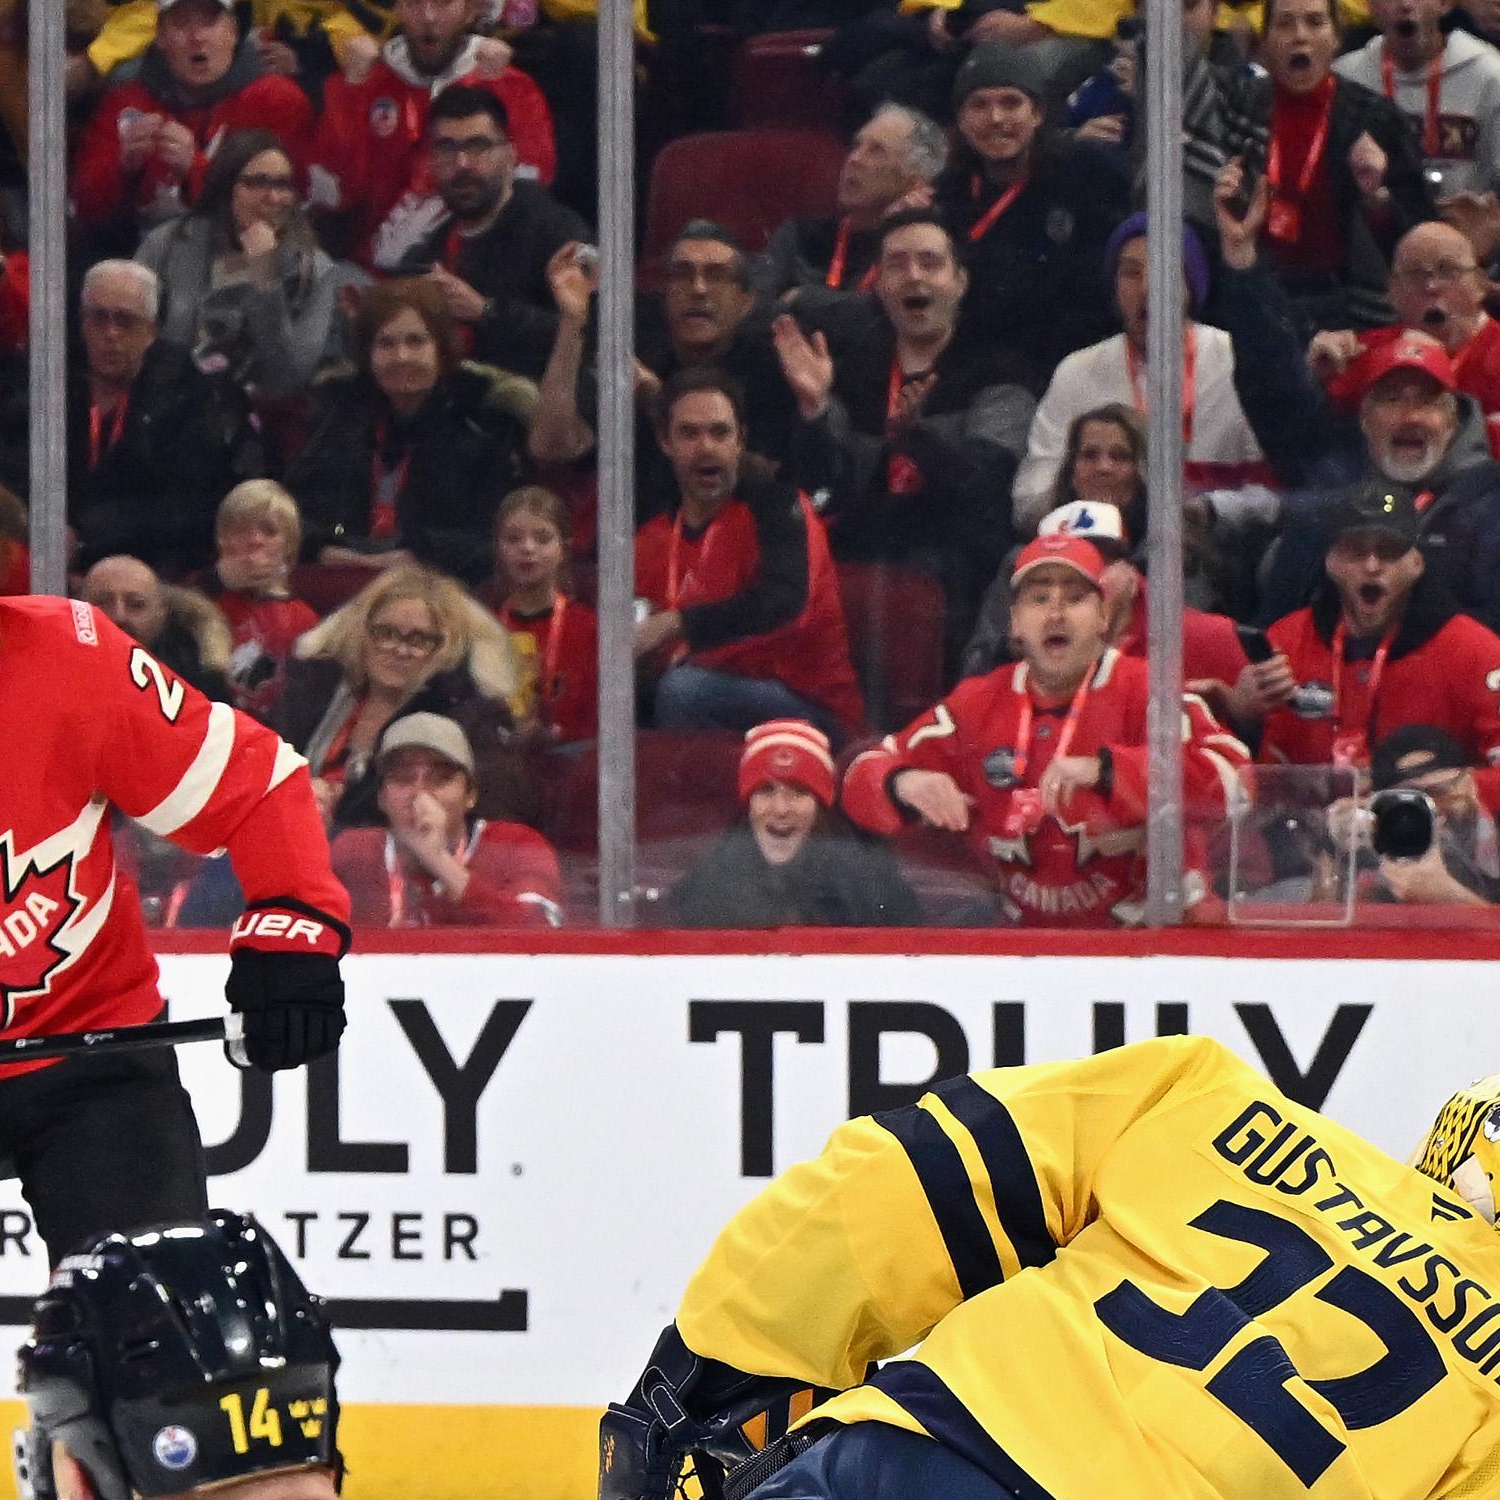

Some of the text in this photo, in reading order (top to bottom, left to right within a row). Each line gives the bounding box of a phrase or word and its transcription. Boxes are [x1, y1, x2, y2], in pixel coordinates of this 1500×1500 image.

[129, 646, 186, 724] 2
[284, 1212, 479, 1261] TZER
[1092, 1198, 1449, 1490] 32
[218, 1387, 284, 1455] 14
